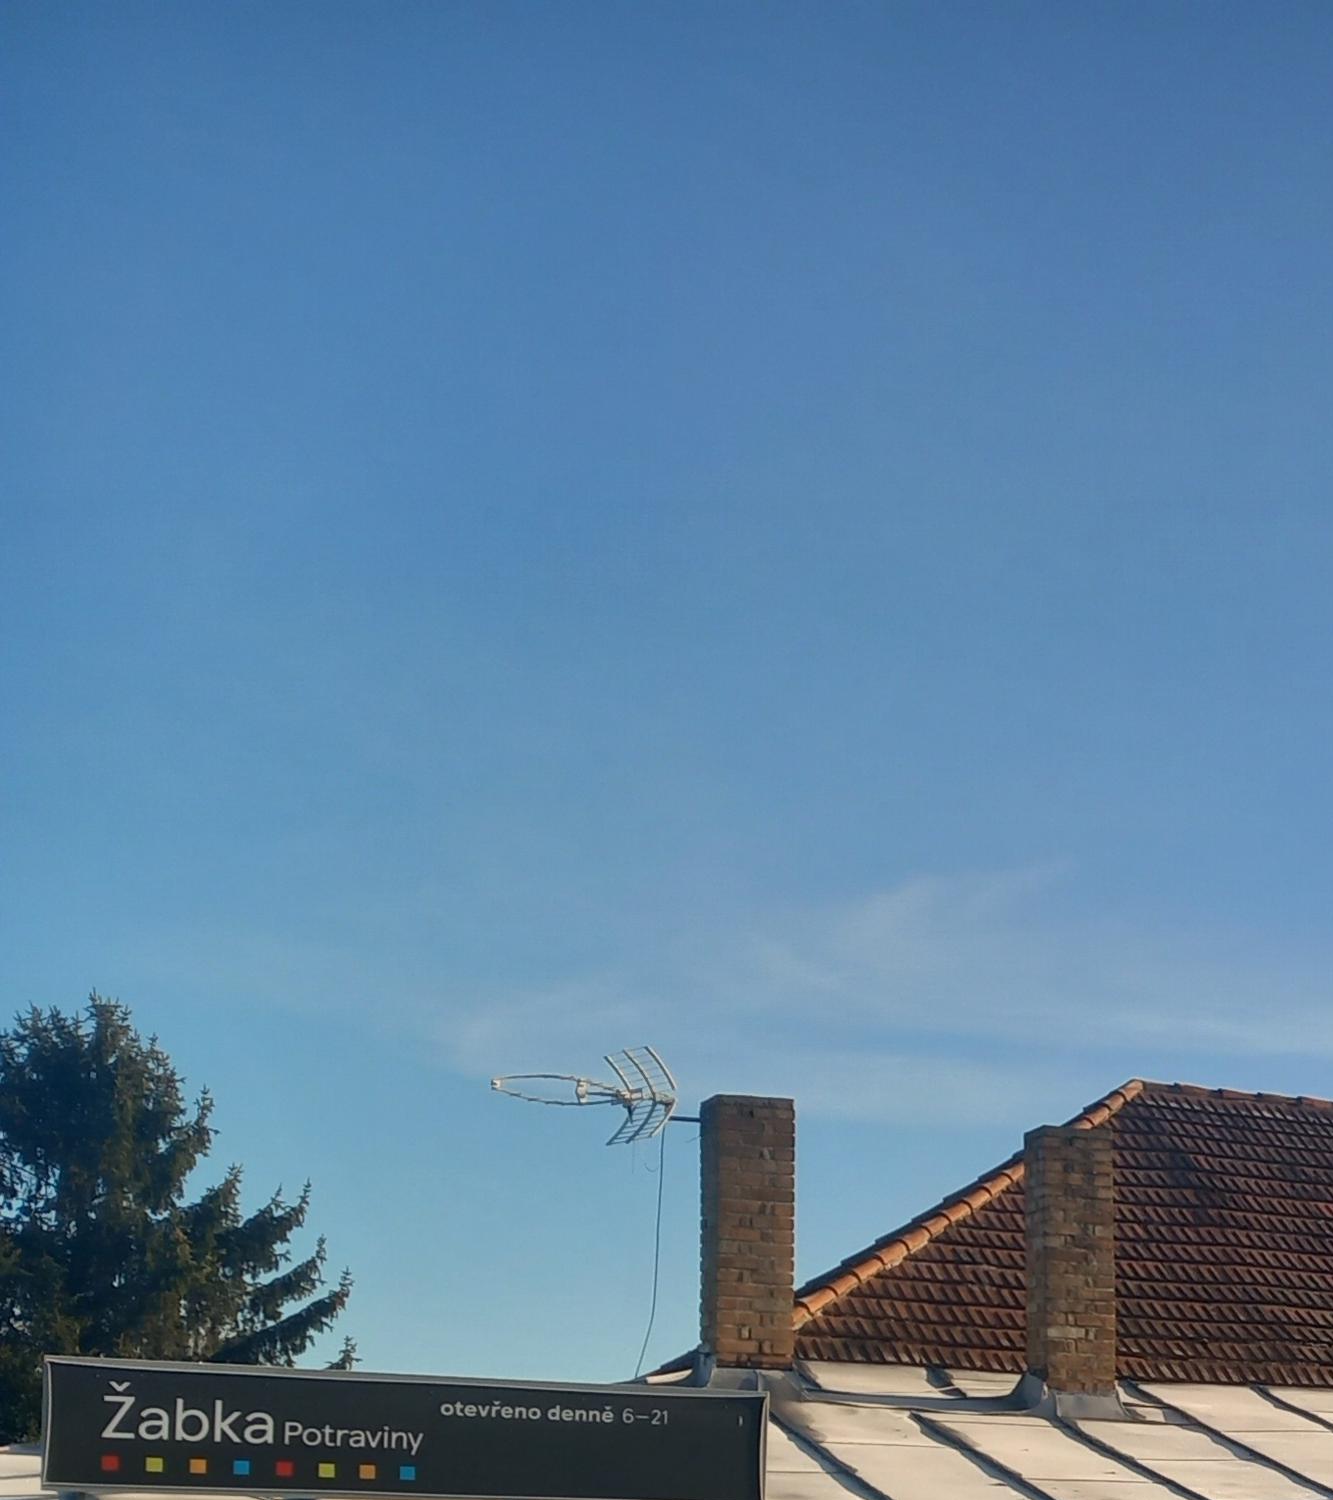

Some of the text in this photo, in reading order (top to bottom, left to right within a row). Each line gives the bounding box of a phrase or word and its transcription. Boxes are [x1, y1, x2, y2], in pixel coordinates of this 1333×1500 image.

[101, 1380, 424, 1456] Žabka Potraviny
[440, 1400, 542, 1421] otevřeno
[547, 1405, 614, 1423] denně
